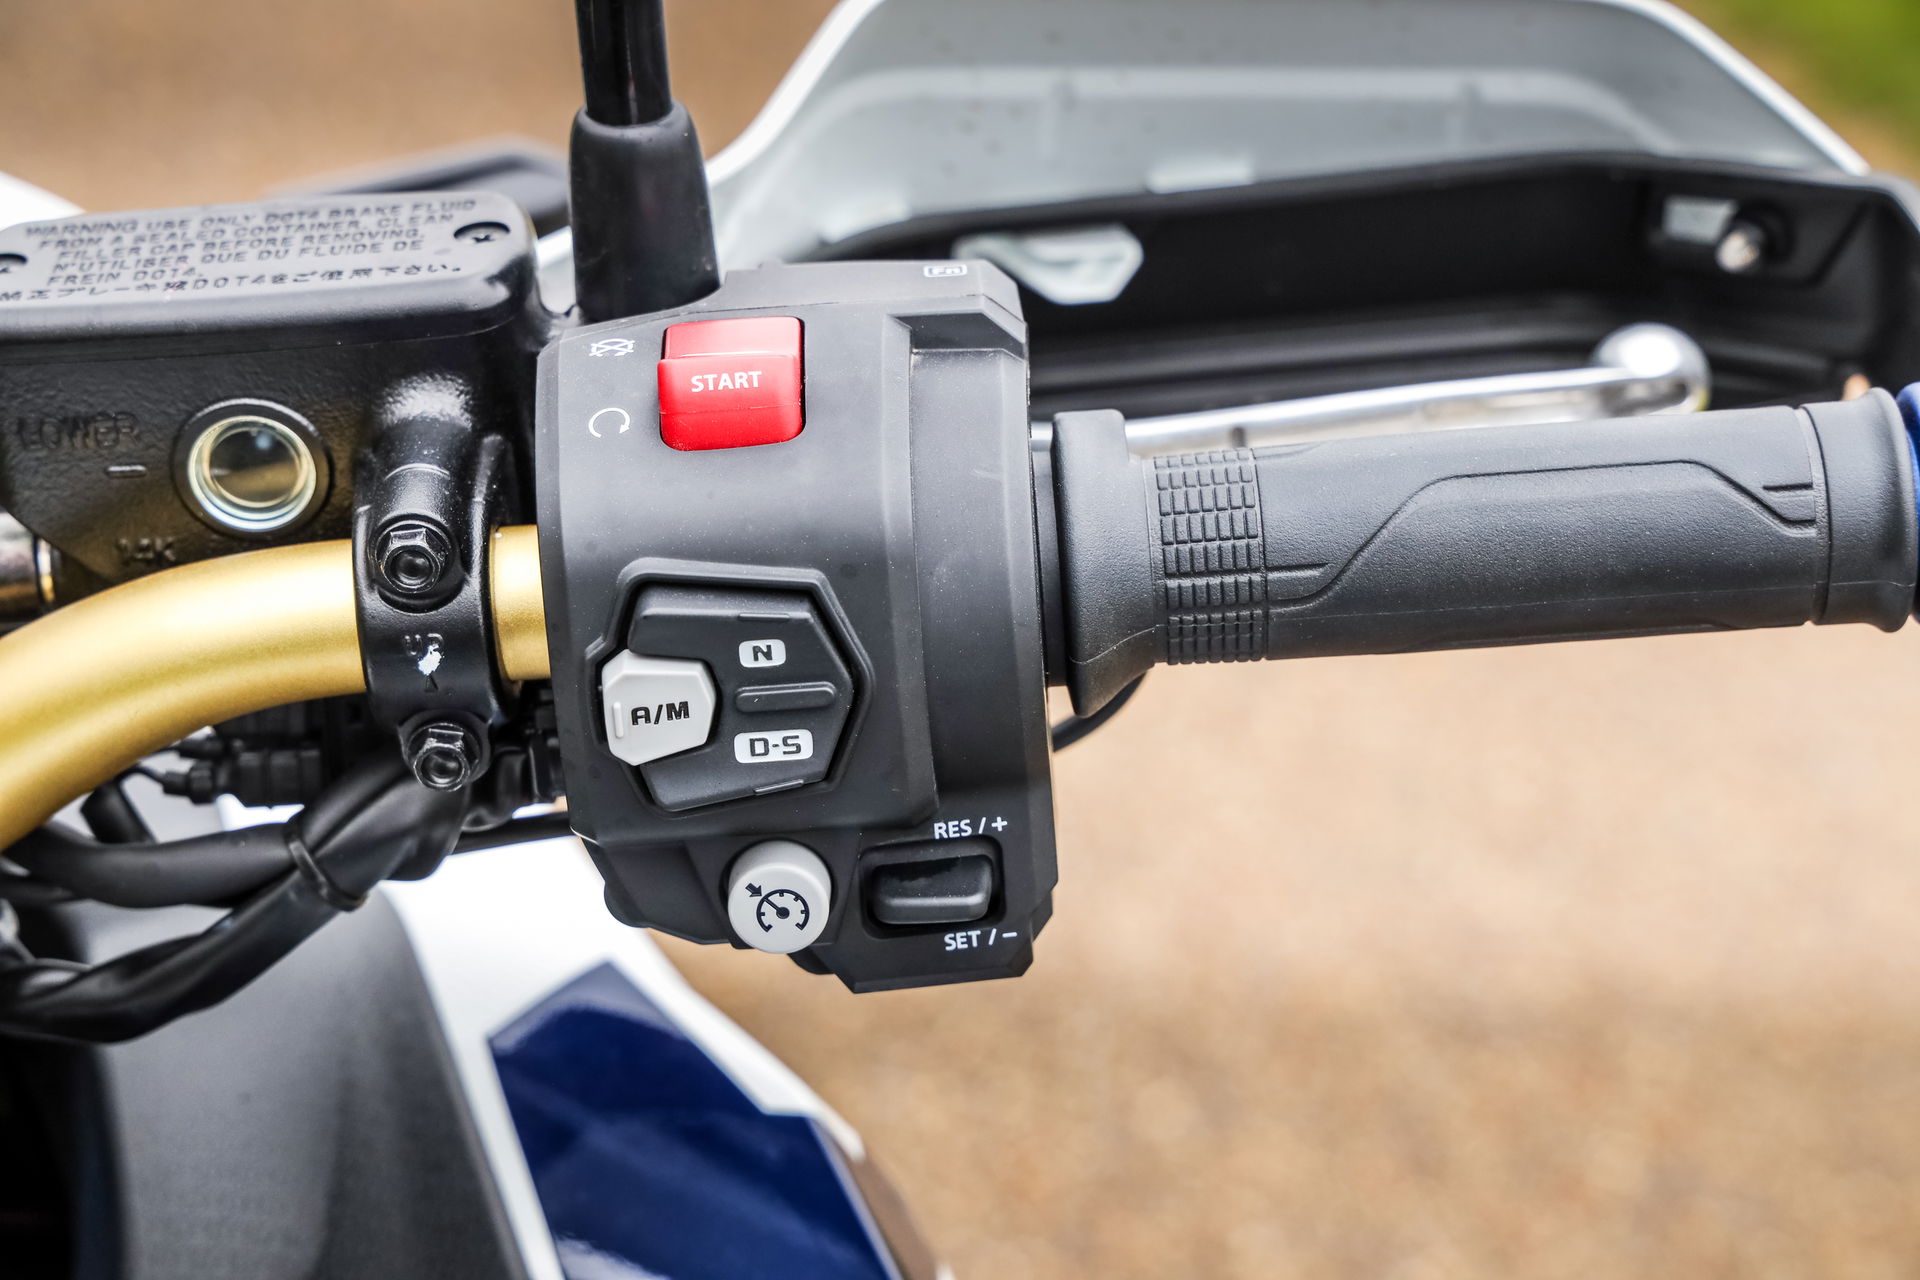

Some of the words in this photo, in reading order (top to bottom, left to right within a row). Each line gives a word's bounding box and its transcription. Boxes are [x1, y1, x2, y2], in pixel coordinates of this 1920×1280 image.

[25, 219, 138, 237] WARNING
[146, 217, 192, 231] USE
[200, 214, 256, 228] ONLY
[329, 204, 404, 219] BRAKE
[411, 200, 477, 213] FLUID
[39, 236, 103, 250] FROM
[110, 235, 124, 246] A
[133, 228, 226, 245] SEALED
[376, 213, 453, 228] CLEAN
[57, 246, 142, 260] FILLER
[149, 242, 196, 254] CAP
[202, 230, 295, 252] BEFORE
[302, 228, 425, 245] REMOVING.
[256, 249, 290, 261] DU
[299, 243, 382, 258] FLUIDE
[392, 240, 424, 251] DE
[46, 272, 122, 286] FREIN
[691, 370, 762, 393] START
[17, 411, 140, 449] LOWER
[752, 644, 773, 662] N
[630, 700, 690, 726] A/M
[749, 735, 802, 757] D-S
